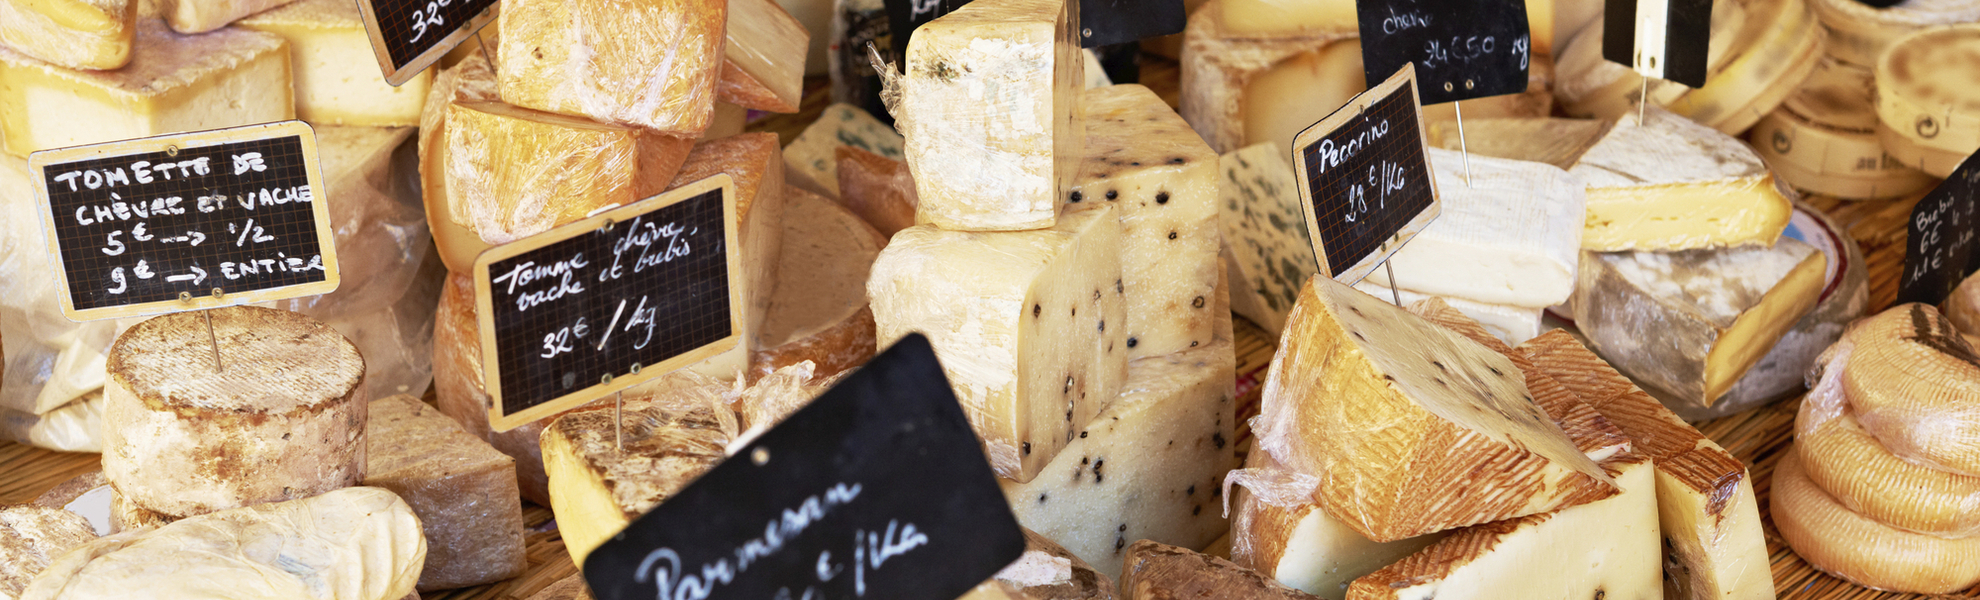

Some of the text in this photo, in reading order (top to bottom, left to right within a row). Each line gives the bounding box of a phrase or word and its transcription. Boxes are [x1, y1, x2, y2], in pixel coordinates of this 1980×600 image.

[1319, 116, 1389, 174] Pecorino
[54, 152, 268, 192] TOMETTE DE
[197, 195, 227, 213] ET
[237, 185, 314, 211] VACHE
[493, 253, 589, 295] Tomme
[516, 234, 690, 312] vache et brebis
[635, 482, 862, 600] Parmesan
